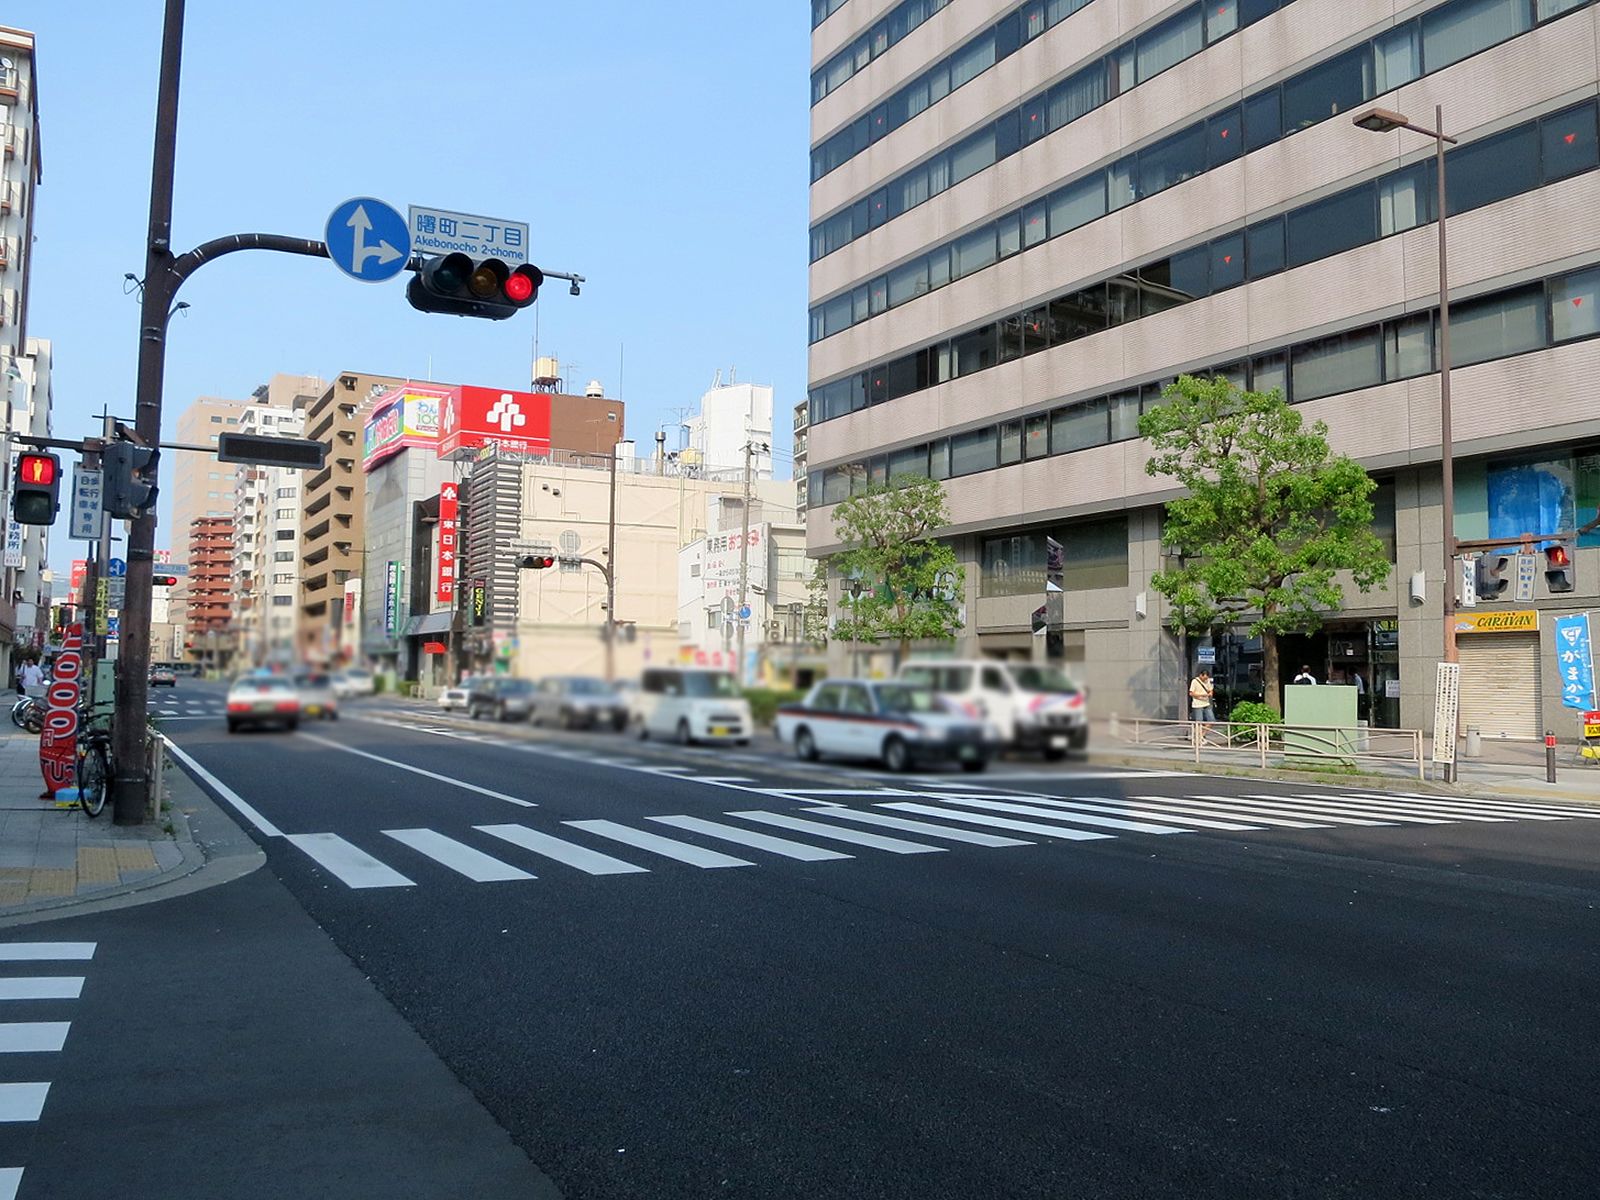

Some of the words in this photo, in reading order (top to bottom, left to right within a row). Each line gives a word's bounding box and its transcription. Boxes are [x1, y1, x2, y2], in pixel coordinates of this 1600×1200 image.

[414, 234, 478, 253] Akebonocho
[481, 244, 524, 260] 2-chome
[416, 214, 522, 247] 曙町二丁目
[441, 520, 455, 594] 東日本銀行
[1477, 614, 1534, 627] CARAVAN
[1560, 650, 1584, 704] がまかつ
